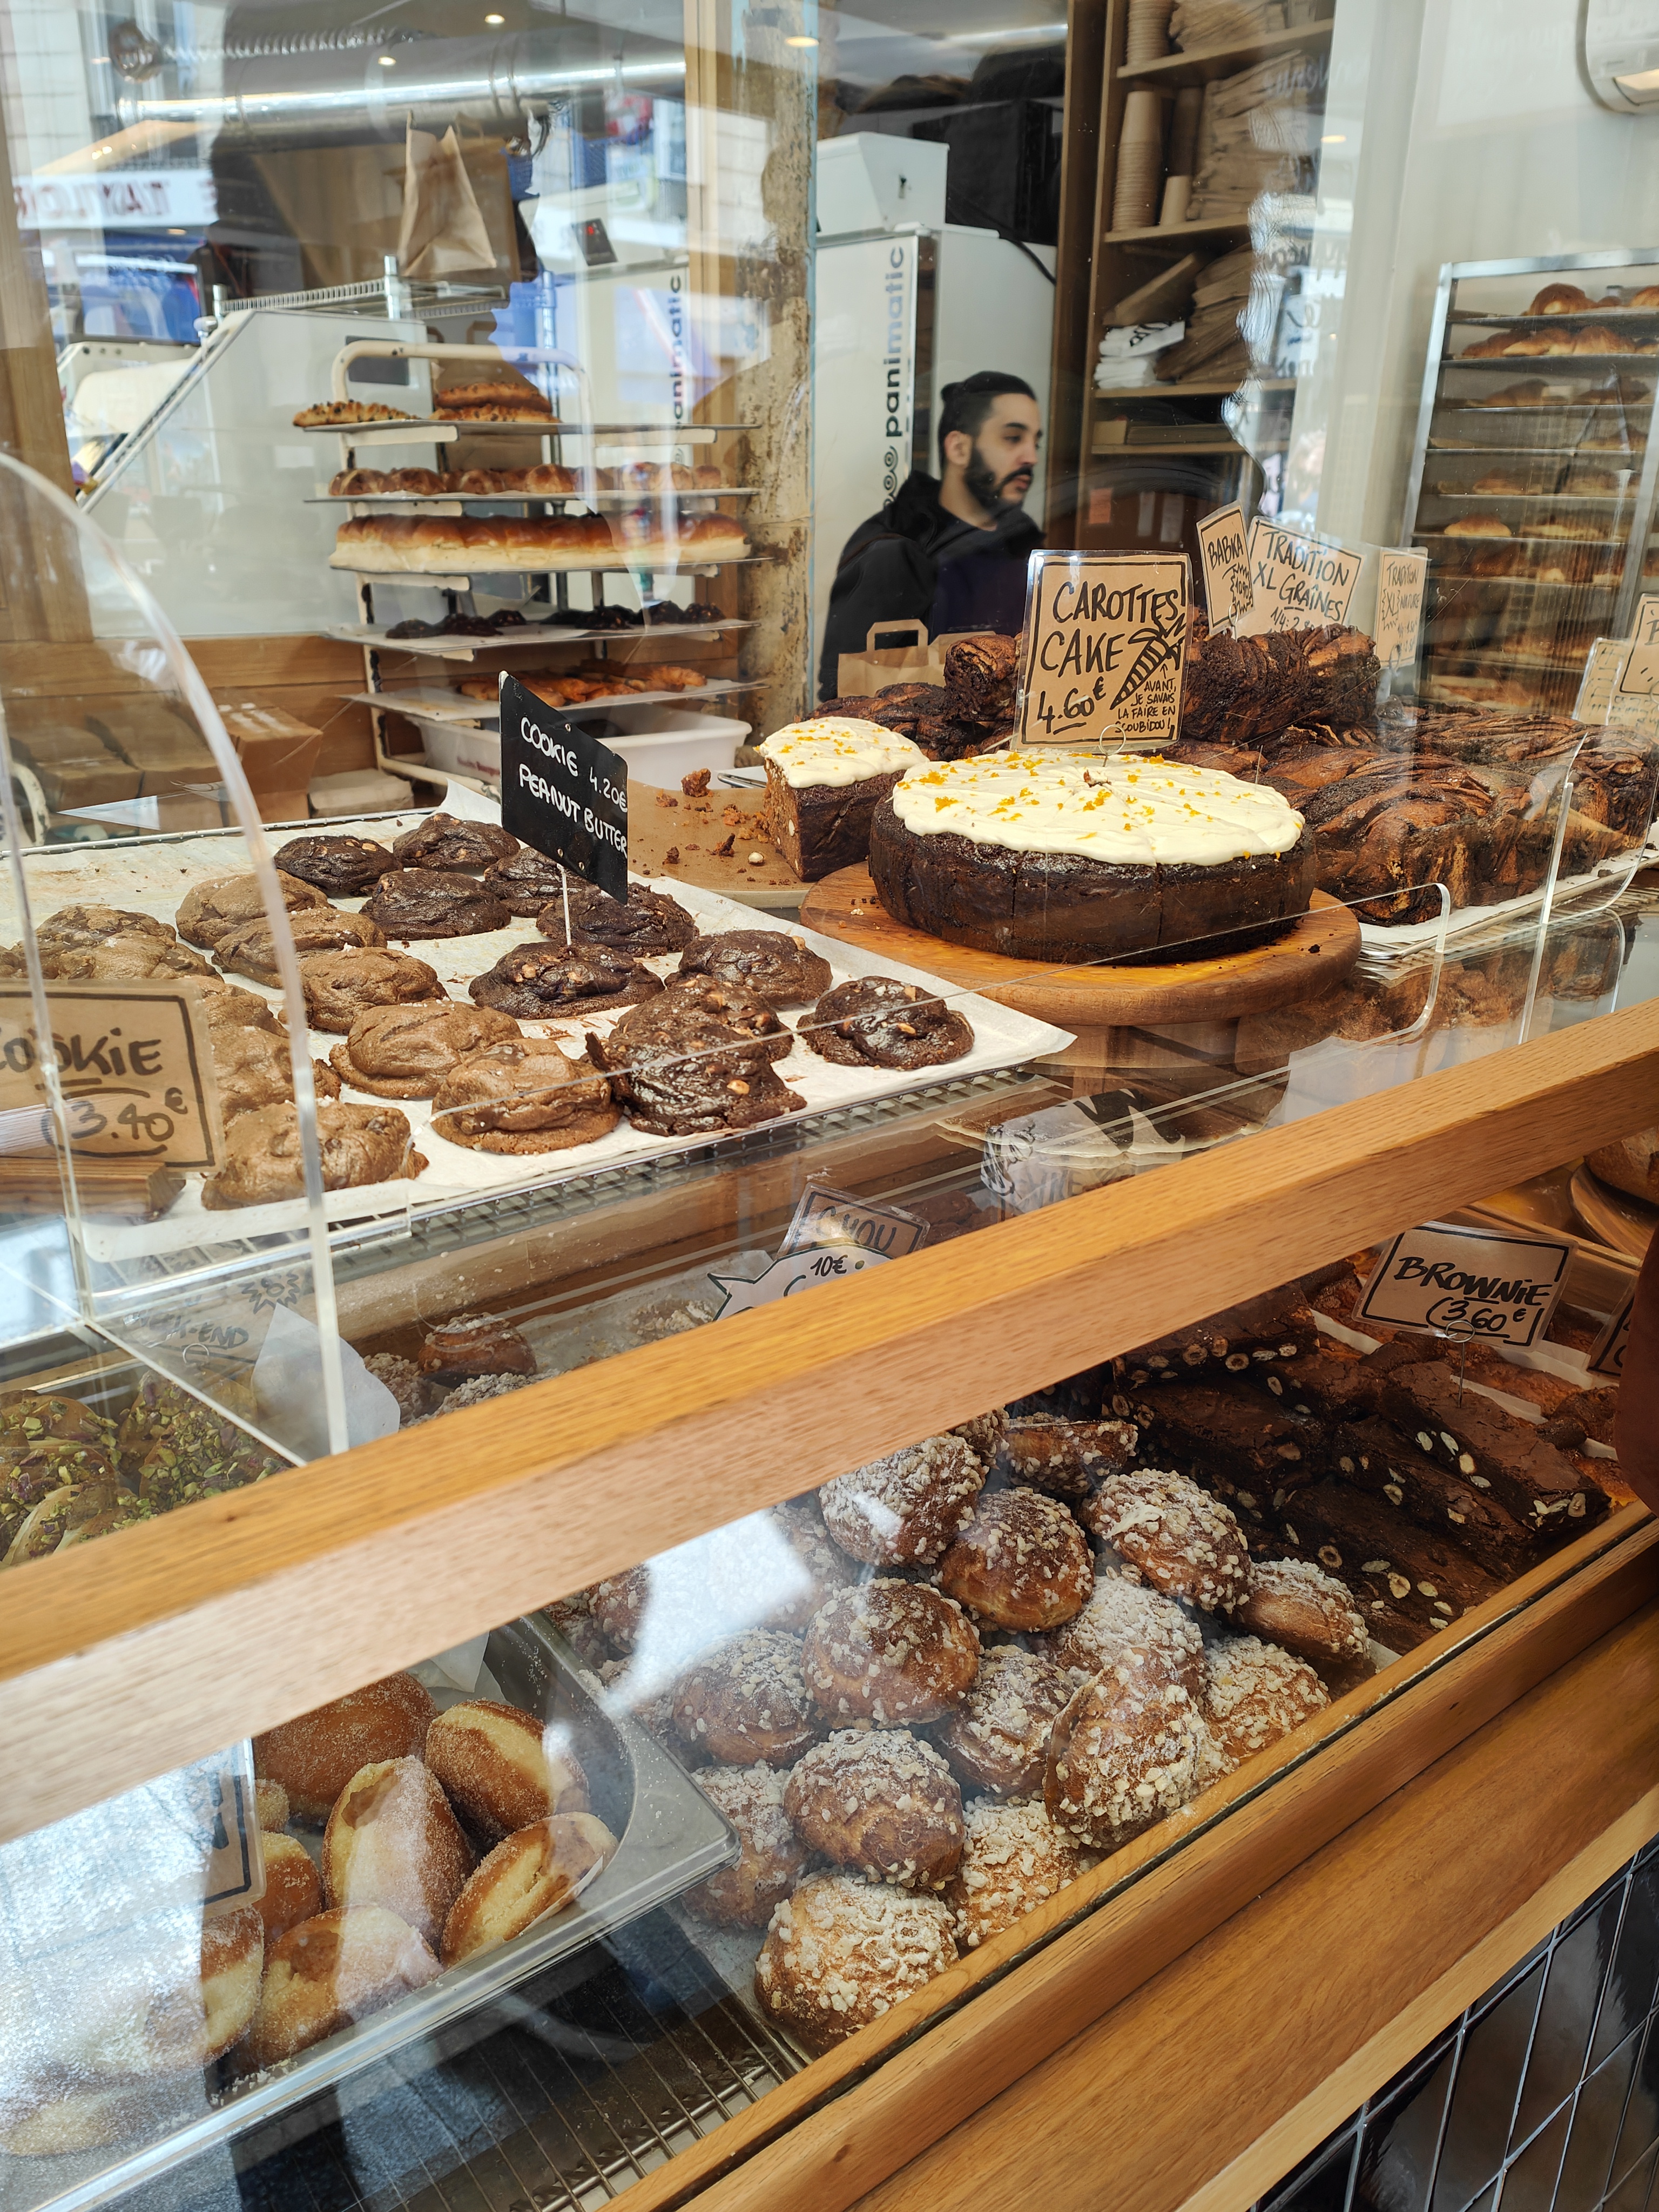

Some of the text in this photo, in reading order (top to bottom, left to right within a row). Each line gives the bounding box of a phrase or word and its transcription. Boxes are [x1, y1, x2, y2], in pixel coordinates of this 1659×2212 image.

[668, 274, 684, 429] animatic
[884, 247, 904, 438] panimatic
[1207, 532, 1244, 570] BABKA
[1253, 561, 1277, 590] XL
[1053, 581, 1178, 623] CAROTTES
[1385, 591, 1399, 619] XL
[1040, 629, 1125, 677] CAKE
[1037, 676, 1106, 734] 4.60€
[1118, 708, 1129, 720] LA
[1162, 705, 1175, 716] EN
[1130, 692, 1143, 706] JE
[521, 716, 578, 777] COOKIE
[519, 763, 628, 859] PEANUT BUTTER
[0, 1027, 164, 1076] OOKIE
[810, 1254, 848, 1277] 10€
[130, 1311, 249, 1350] K-END
